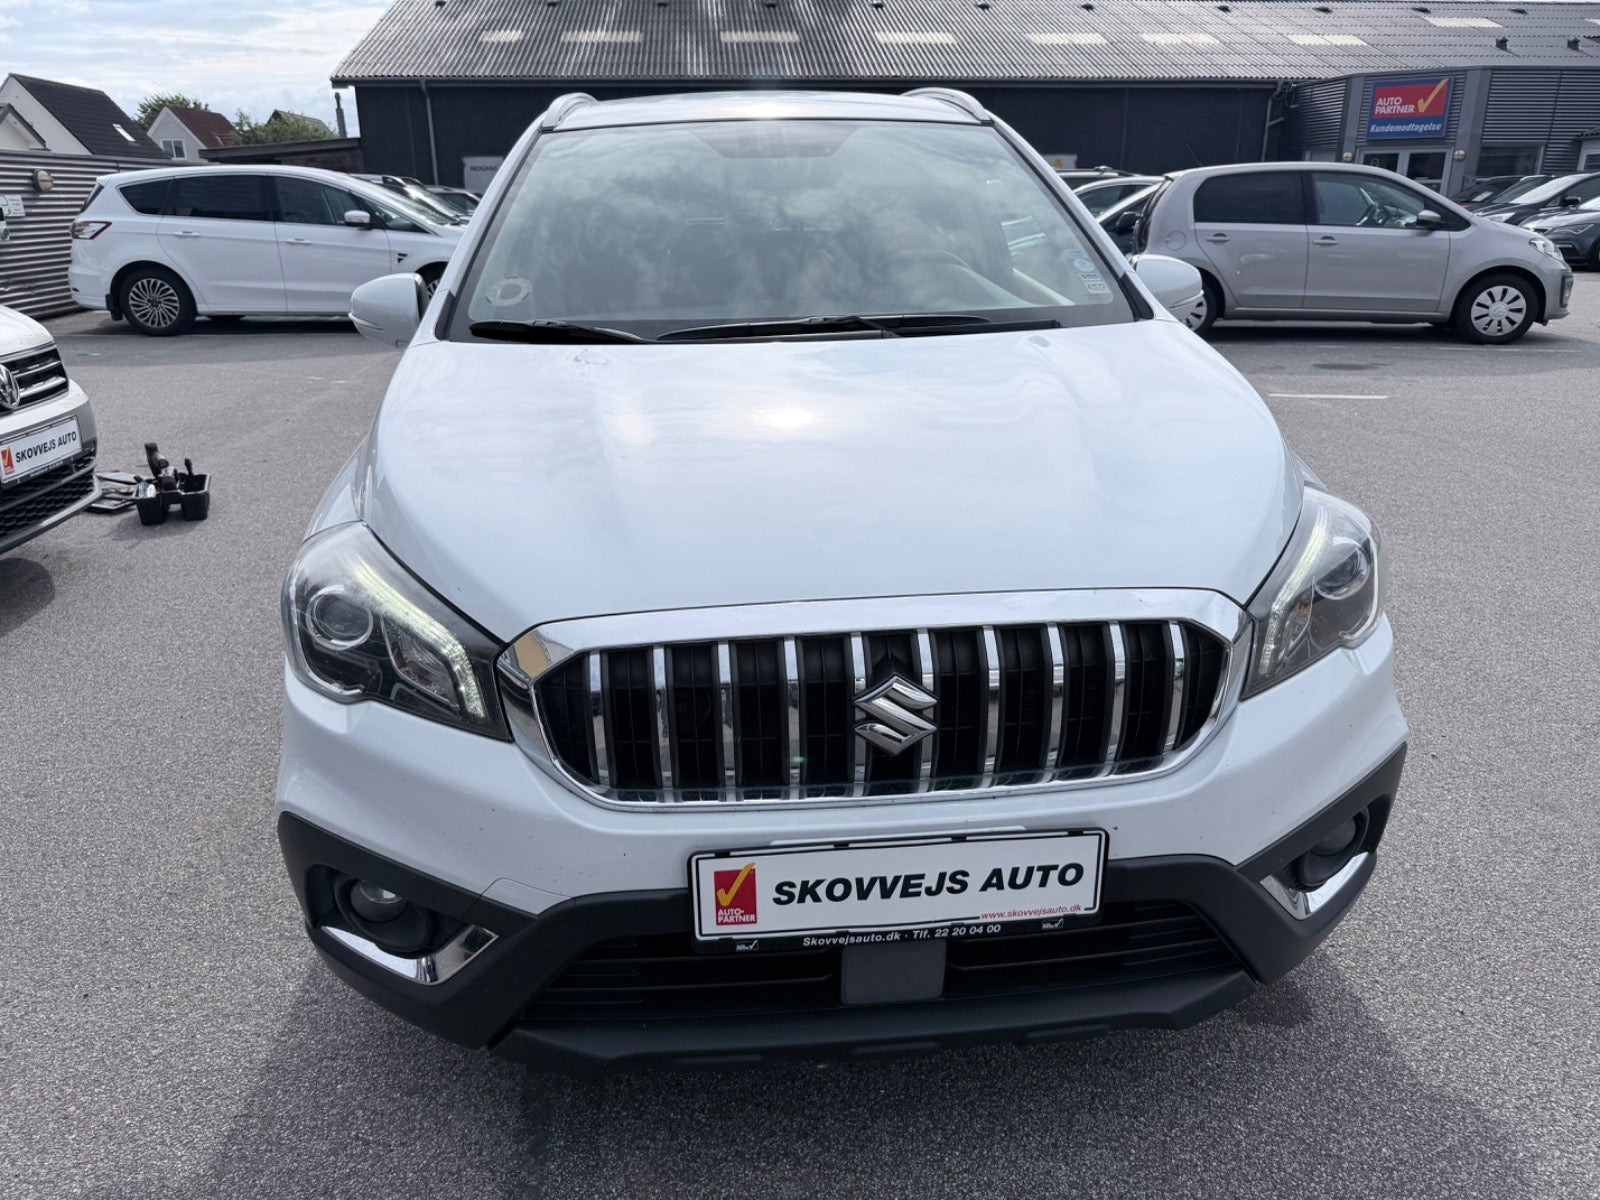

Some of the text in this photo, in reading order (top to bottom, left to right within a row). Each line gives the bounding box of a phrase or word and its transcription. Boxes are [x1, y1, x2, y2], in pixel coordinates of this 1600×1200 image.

[1376, 96, 1402, 106] AUTO
[1374, 104, 1415, 115] PARTNER
[1369, 122, 1442, 133] Kundemodtagelse
[15, 431, 77, 463] SKOVVEJS AUTO
[772, 862, 1084, 906] SKOVVEJS AUTO
[981, 904, 1082, 920] www.skovvejsauto.dk
[717, 914, 756, 924] PARTNER
[803, 923, 1001, 947] Skovvejsauto.dk Tlf. 22 20 04 00
